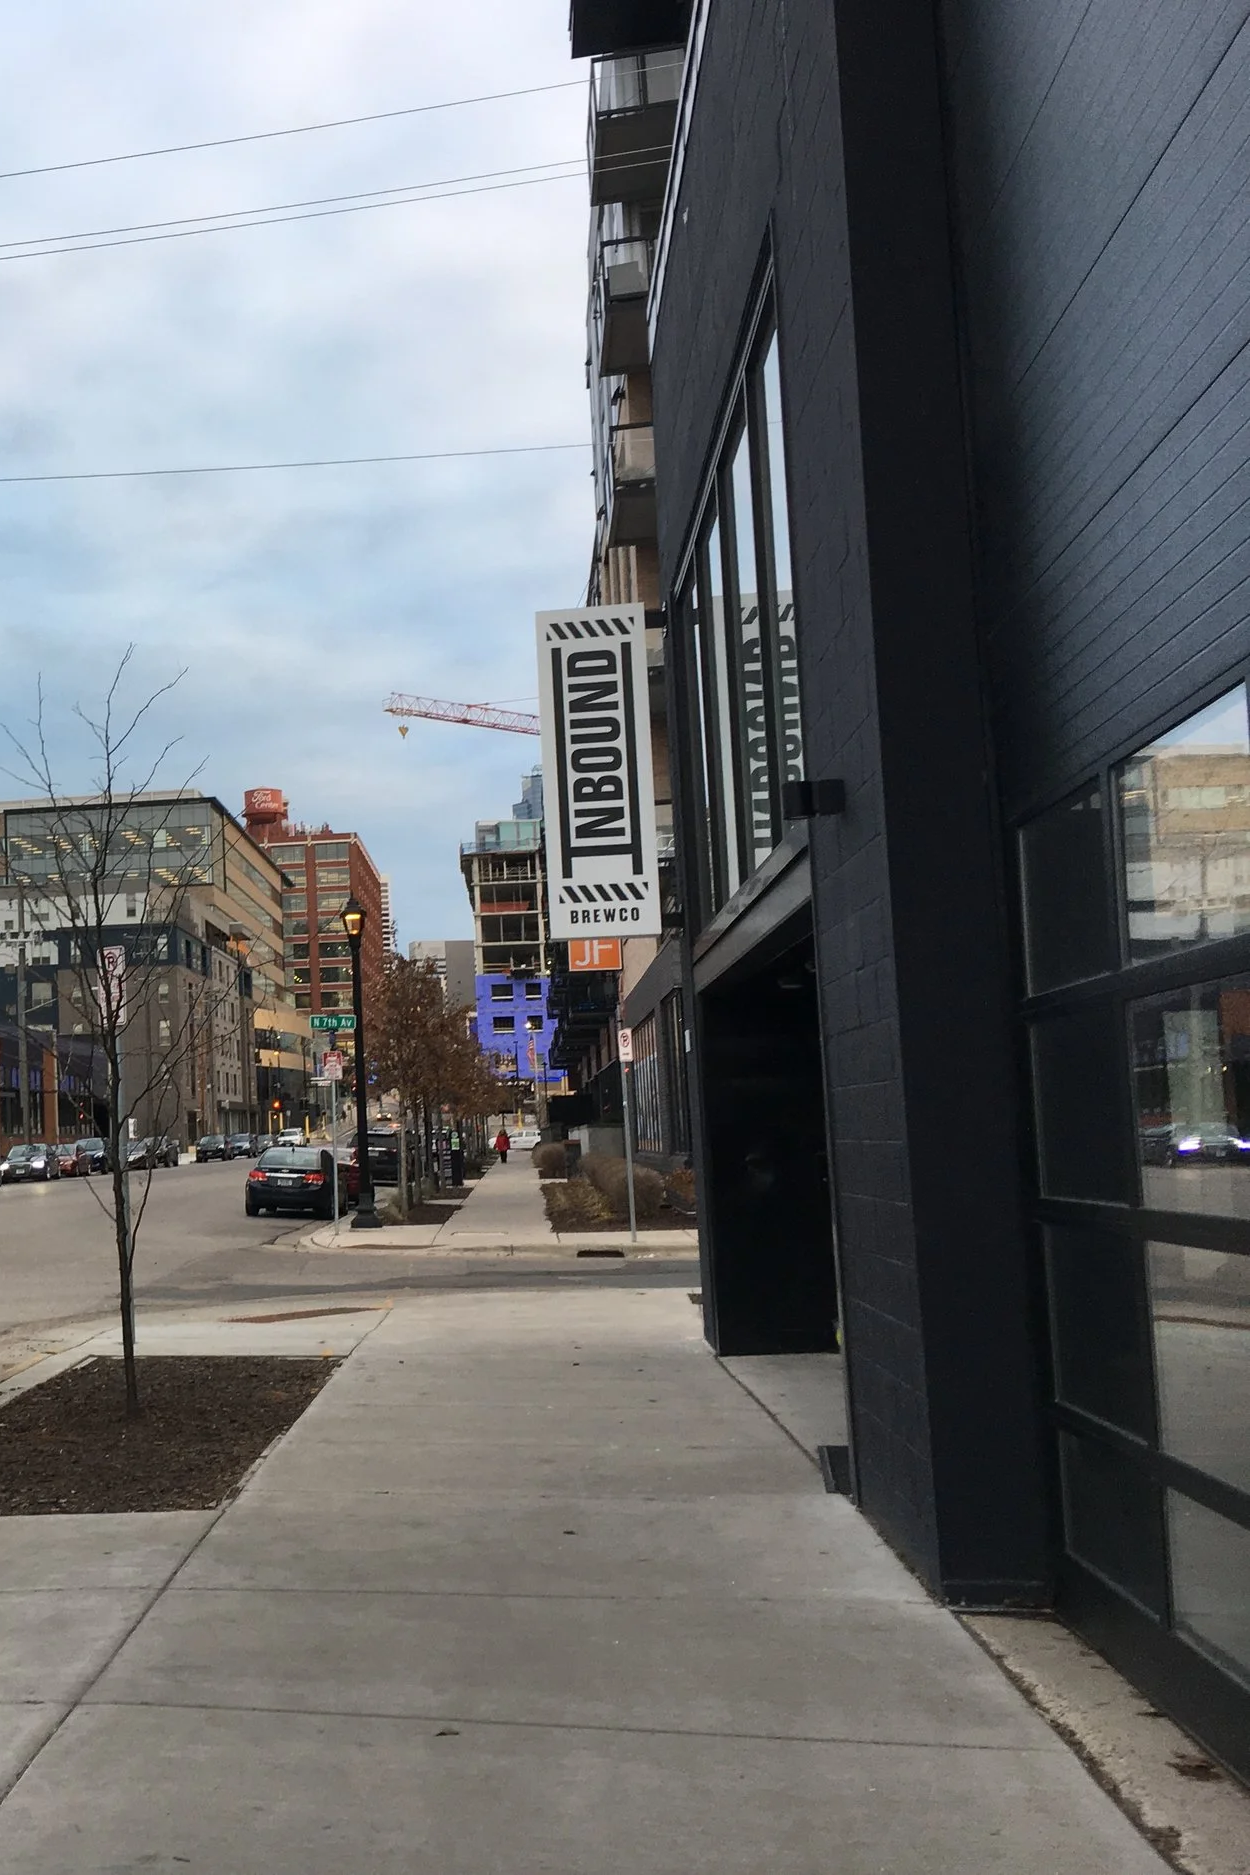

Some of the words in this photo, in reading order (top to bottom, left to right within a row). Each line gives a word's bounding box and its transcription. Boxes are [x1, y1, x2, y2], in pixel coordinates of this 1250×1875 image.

[551, 642, 643, 879] INBOUND
[252, 790, 271, 802] Ford
[570, 907, 640, 924] BREWCO
[313, 1017, 320, 1027] N
[323, 1017, 338, 1027] 7th
[340, 1018, 353, 1027] Av
